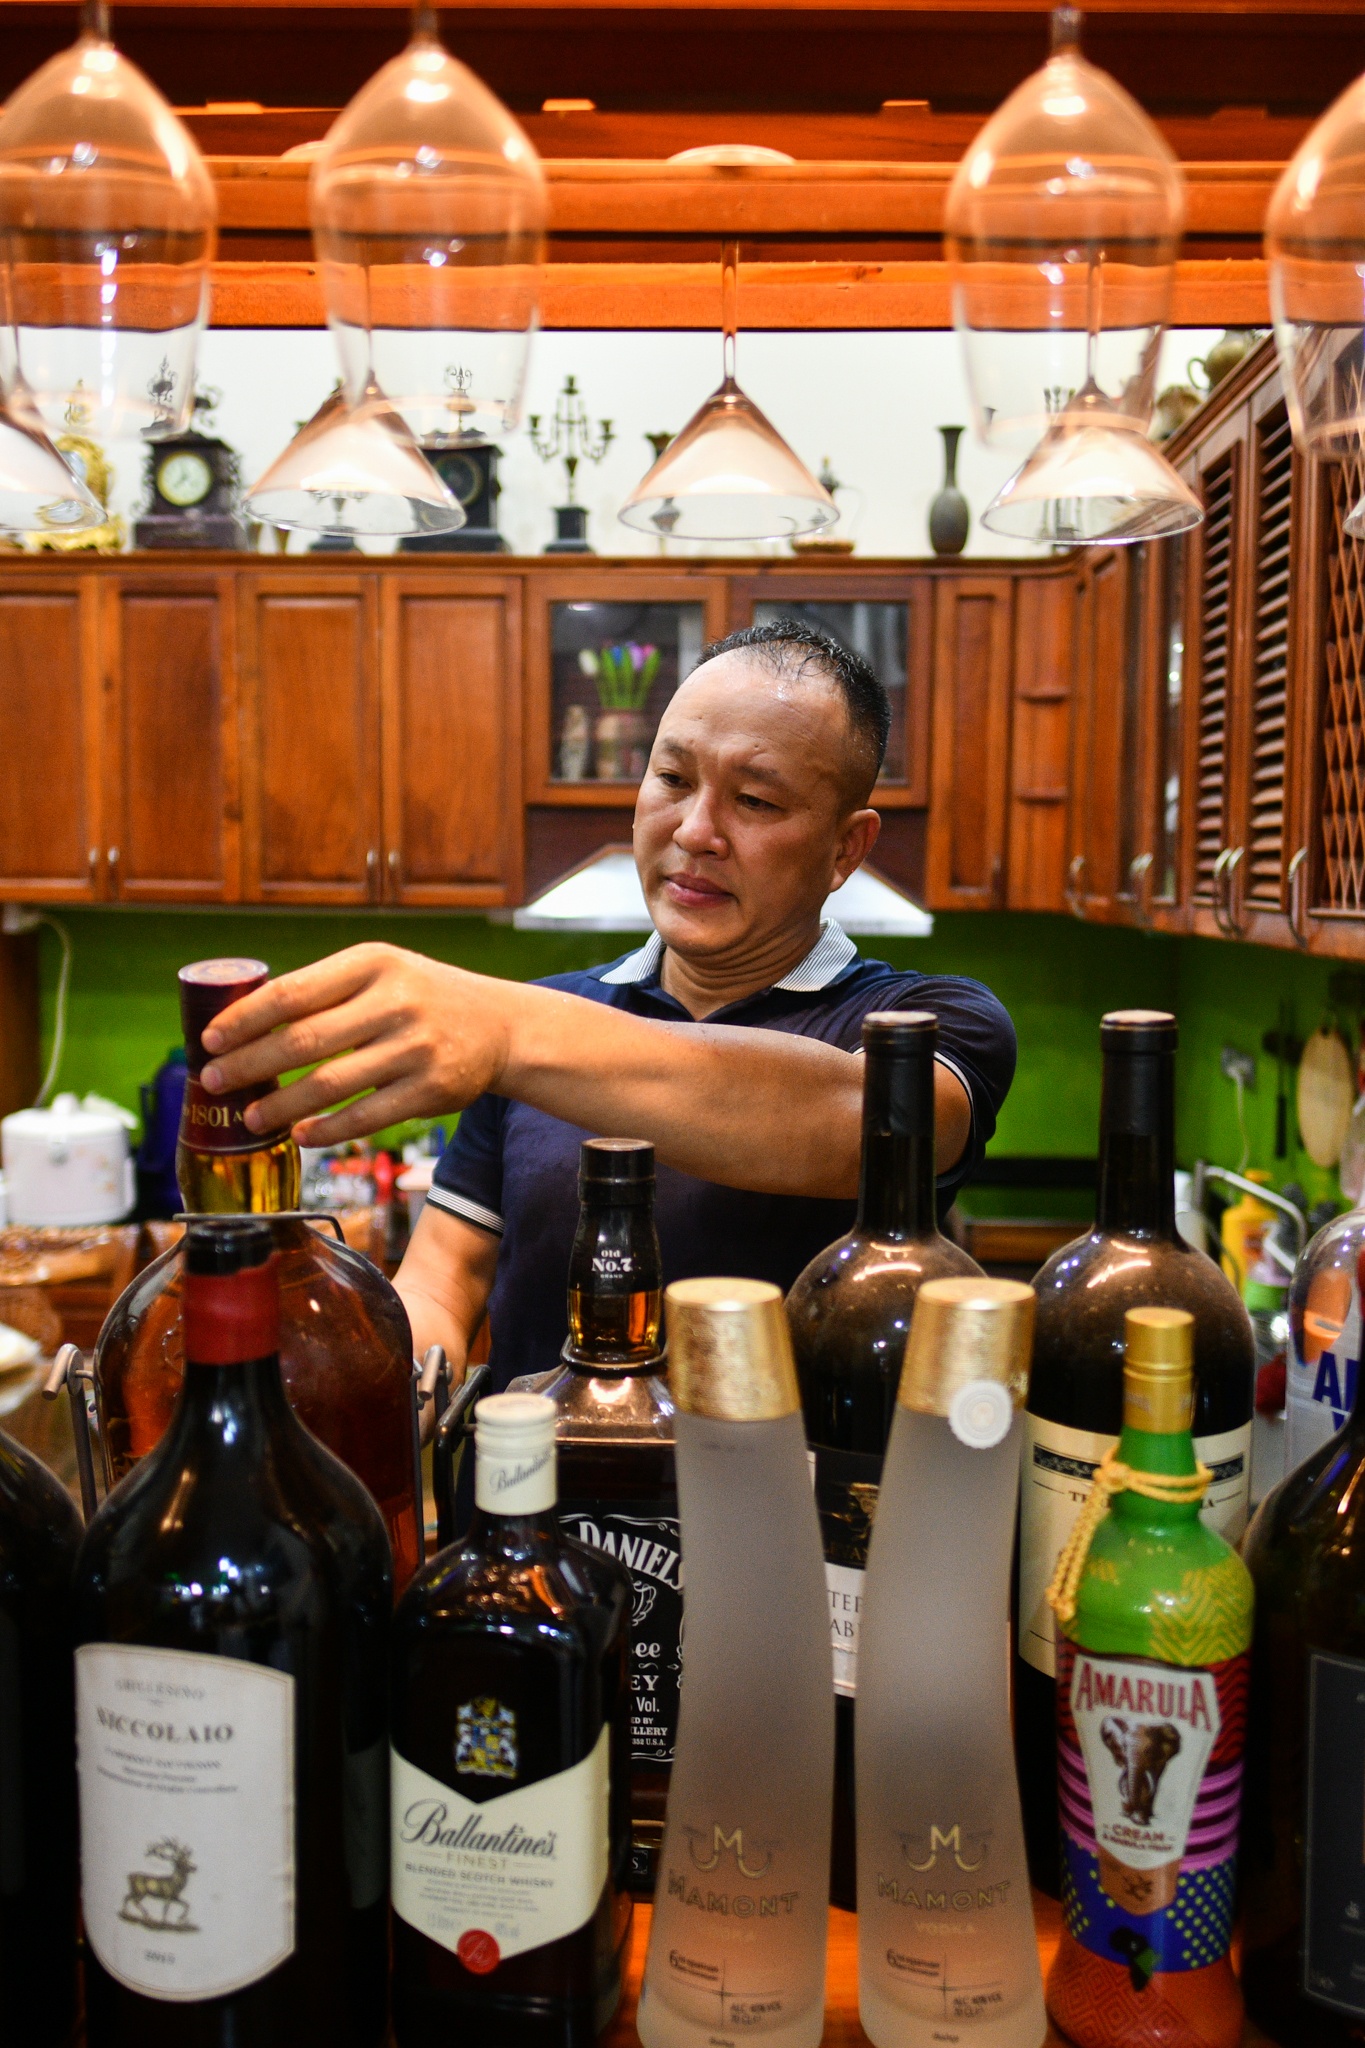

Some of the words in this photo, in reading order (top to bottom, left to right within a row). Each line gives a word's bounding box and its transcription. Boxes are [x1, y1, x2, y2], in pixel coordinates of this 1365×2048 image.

[600, 1249, 621, 1258] Old
[591, 1257, 634, 1273] No.7
[636, 1696, 660, 1713] Vol.
[1075, 1661, 1212, 1733] AMARULA
[400, 1797, 558, 1859] Ballantine's
[1112, 1823, 1165, 1841] CREAM
[446, 1851, 509, 1870] FINEST
[667, 1868, 800, 1919] MAMONT
[877, 1872, 1012, 1912] MAMONT
